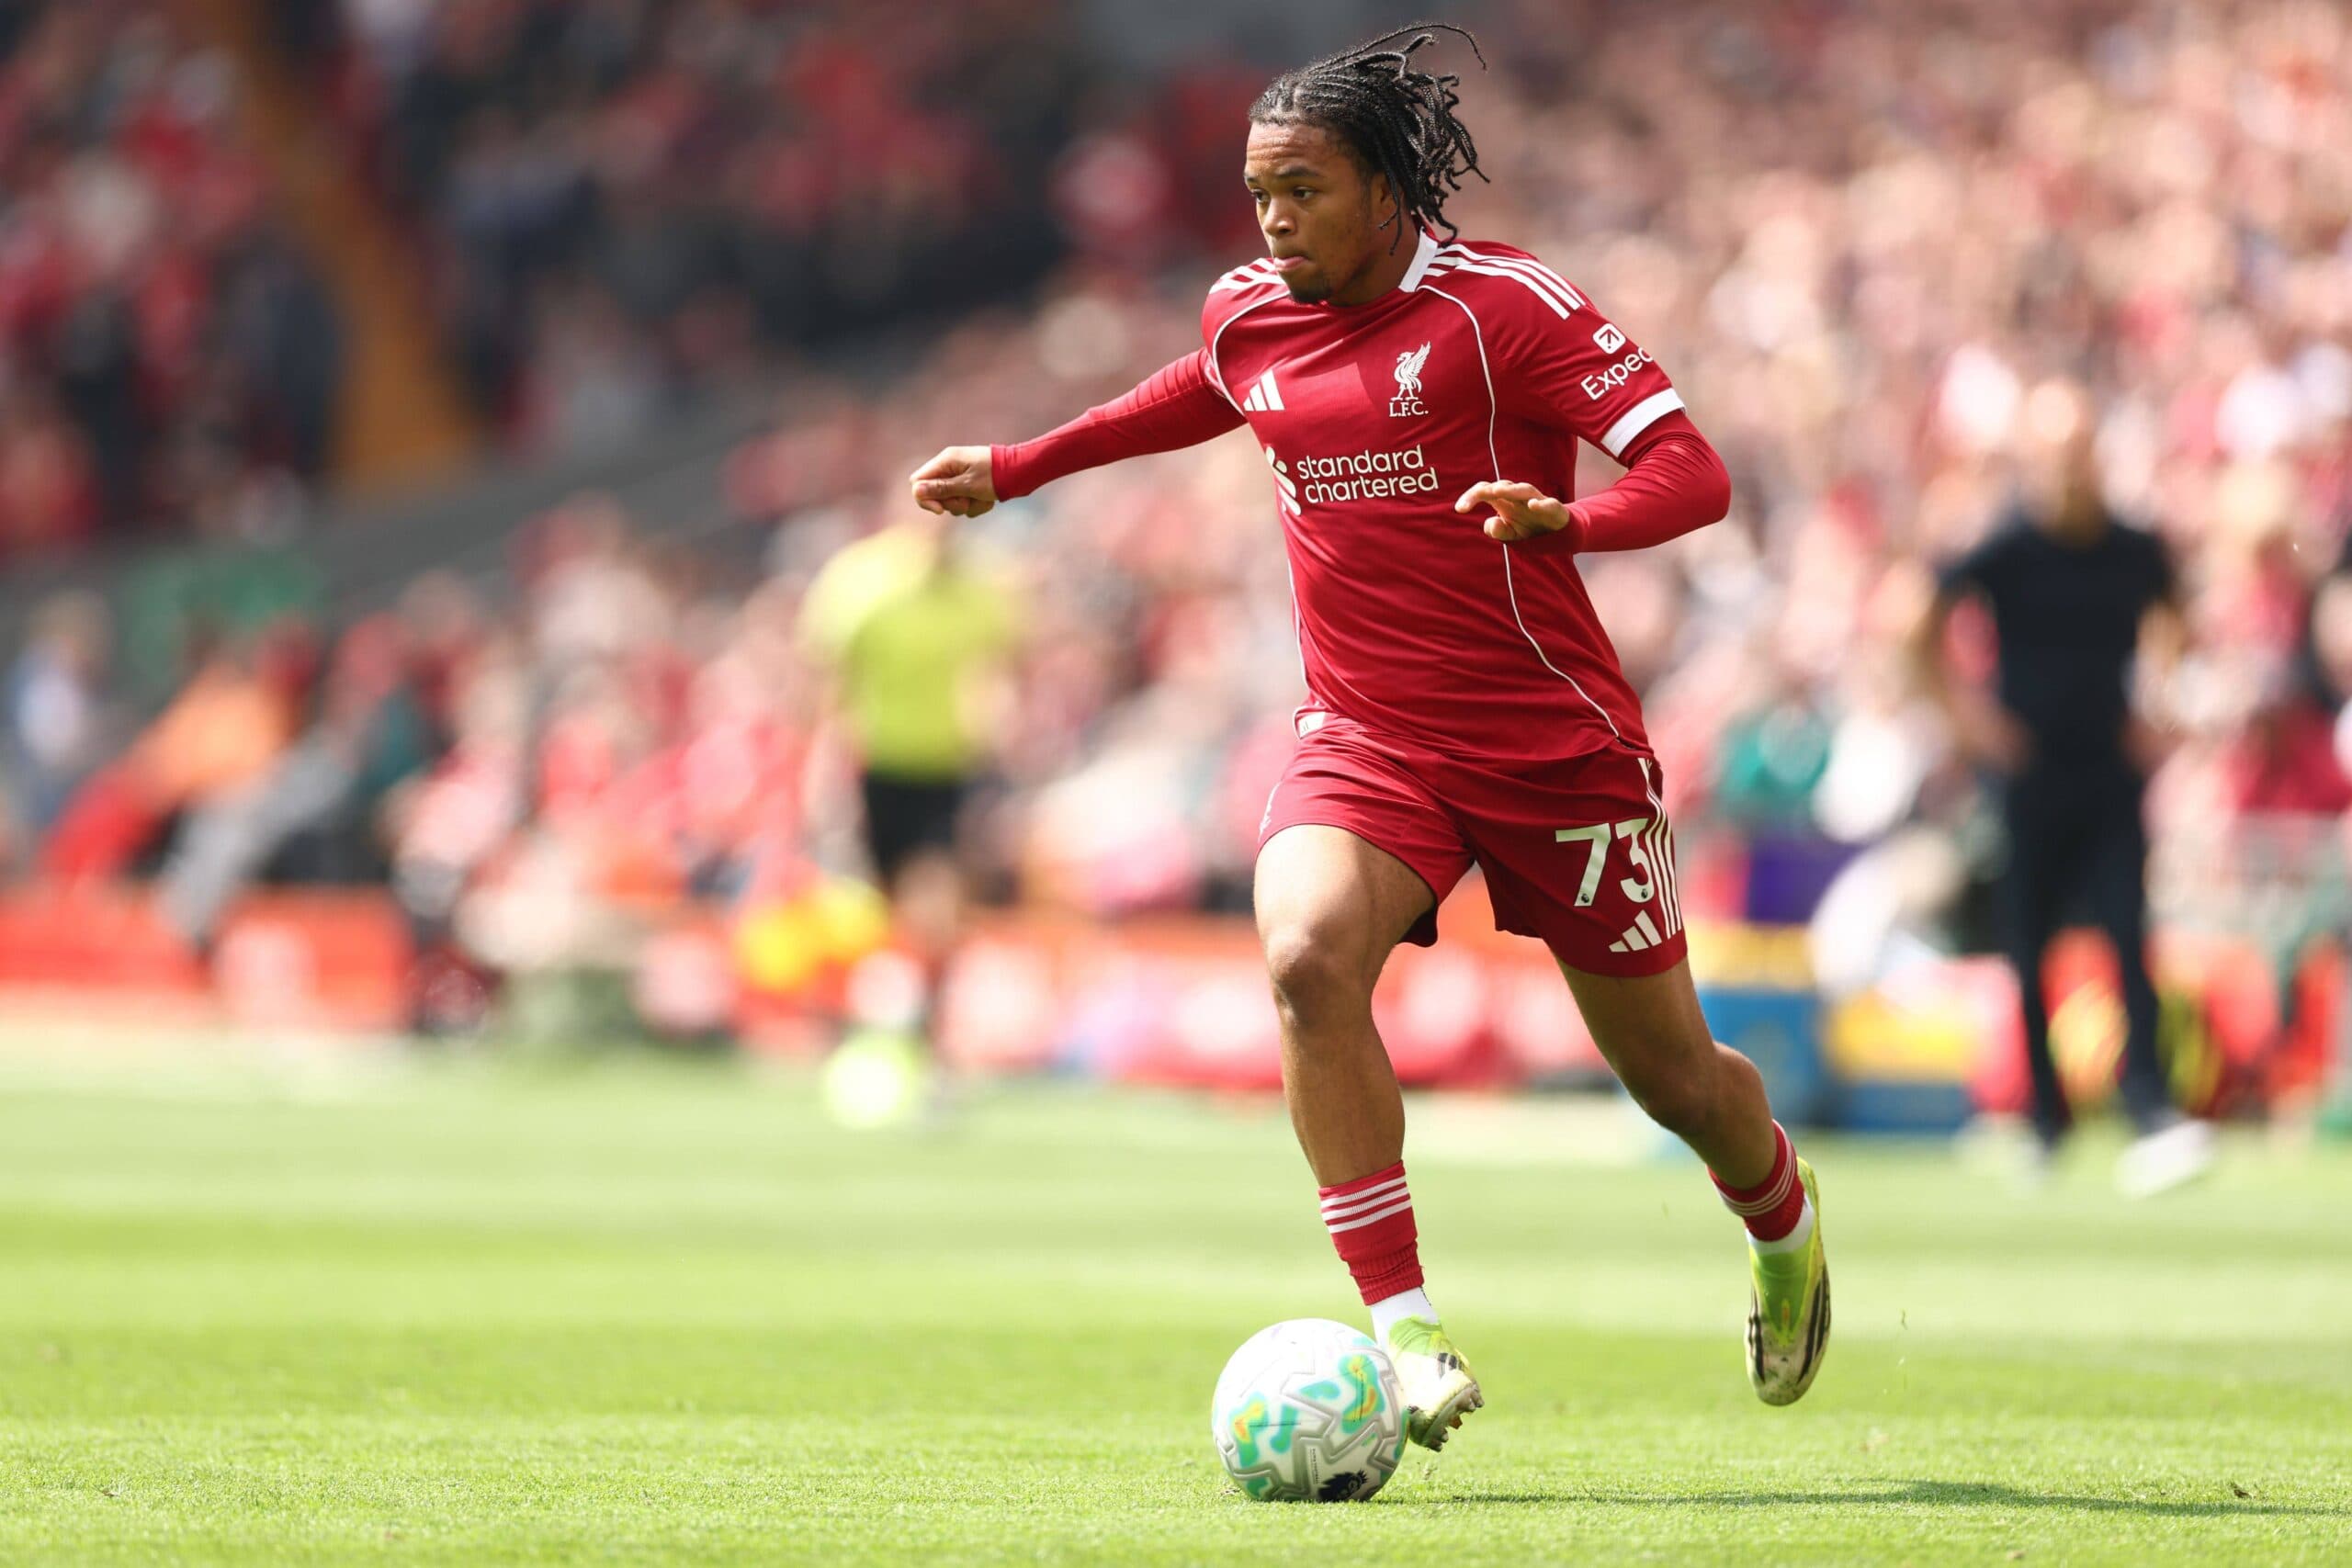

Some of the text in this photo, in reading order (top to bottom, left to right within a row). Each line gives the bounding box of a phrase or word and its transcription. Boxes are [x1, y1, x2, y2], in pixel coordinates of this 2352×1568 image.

[1389, 400, 1429, 417] L.F.C.
[1296, 444, 1424, 479] standard
[1305, 467, 1439, 503] chartered
[1555, 818, 1655, 907] 73
